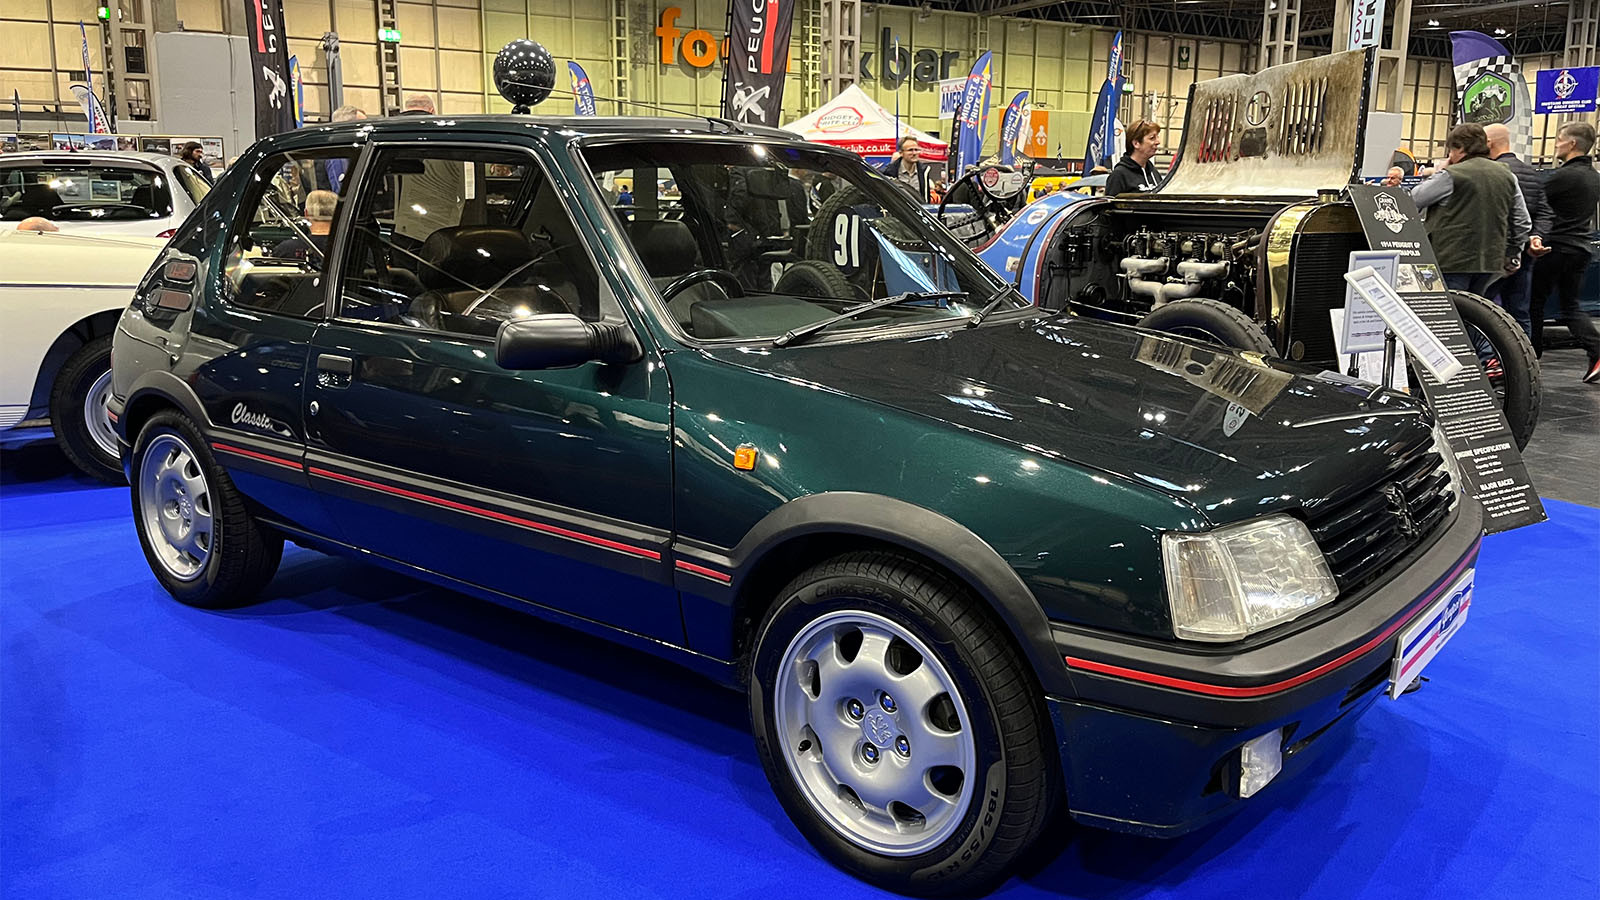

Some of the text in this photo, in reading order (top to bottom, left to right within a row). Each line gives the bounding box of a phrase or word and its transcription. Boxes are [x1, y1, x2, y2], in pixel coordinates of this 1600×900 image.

[883, 27, 960, 83] bar
[961, 82, 979, 121] MIDGET
[967, 95, 981, 129] SPRITE
[834, 213, 860, 268] 91
[231, 401, 272, 430] Classic
[1473, 442, 1511, 456] SPECIFICATION
[961, 788, 999, 862] 185/55
